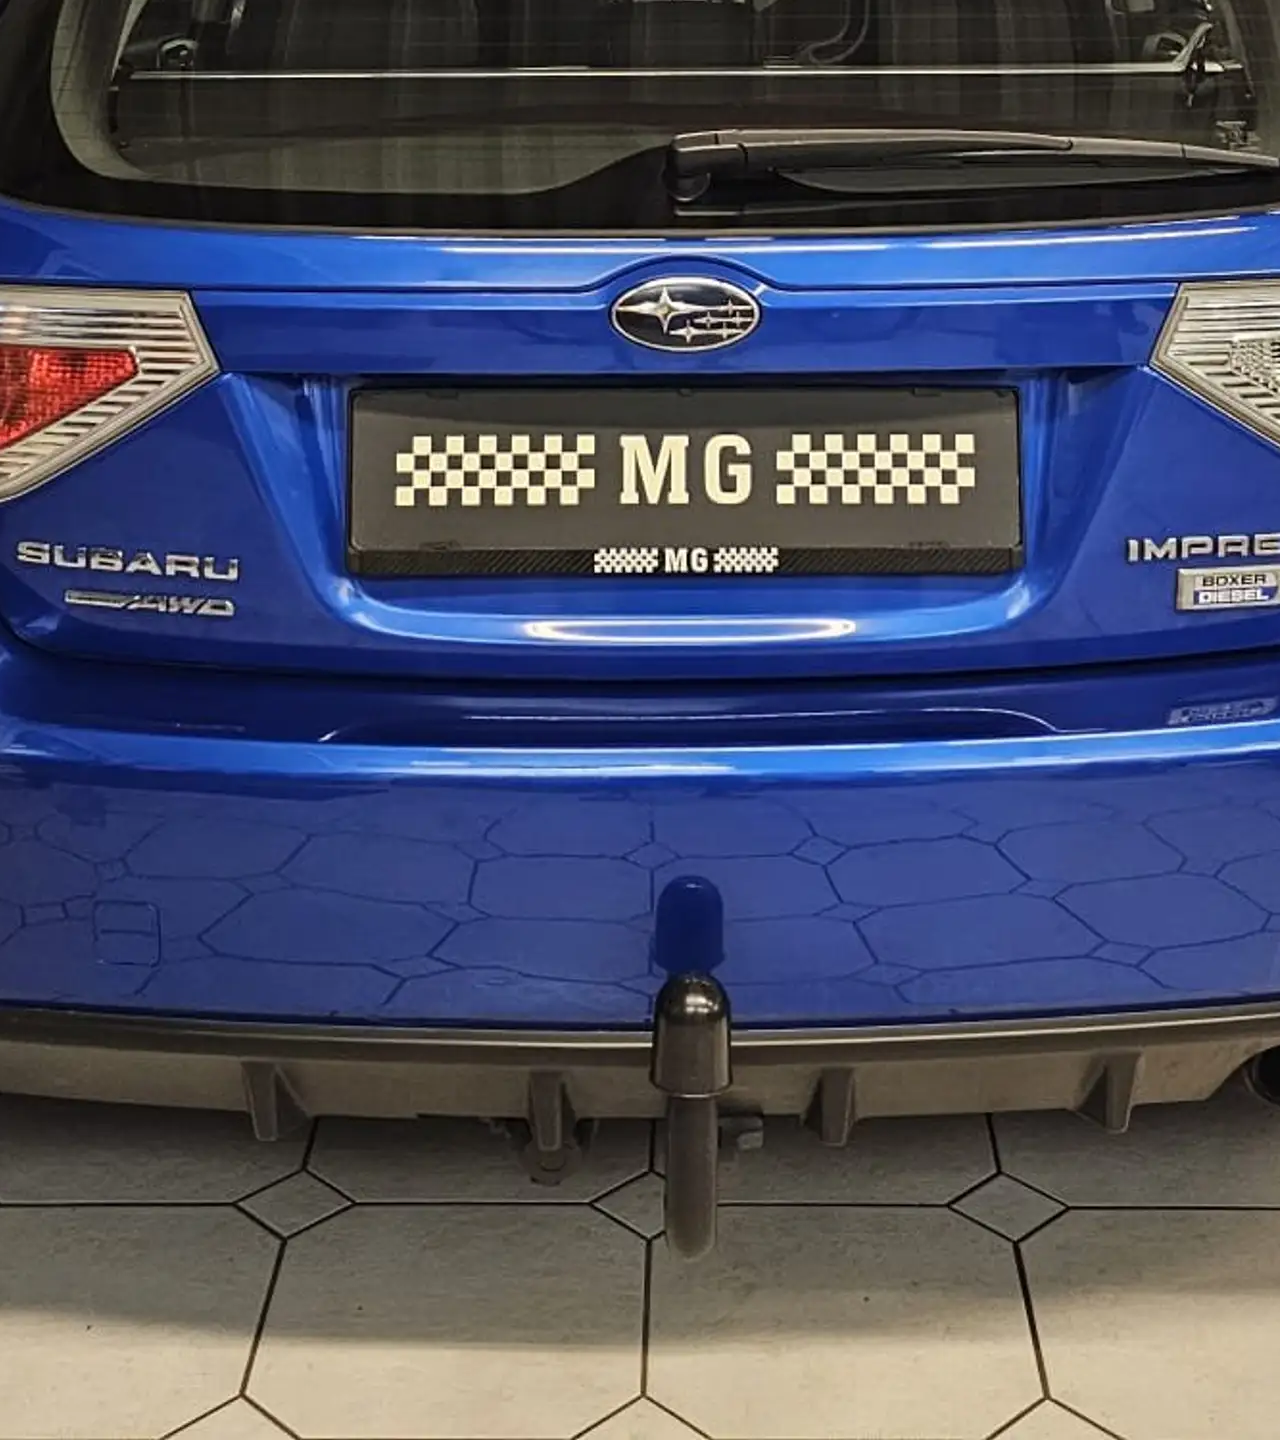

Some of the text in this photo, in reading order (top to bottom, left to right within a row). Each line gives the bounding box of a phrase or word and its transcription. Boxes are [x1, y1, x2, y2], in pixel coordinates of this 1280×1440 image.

[619, 433, 753, 505] MG
[17, 541, 240, 582] SUBARU
[664, 547, 709, 573] MG
[1202, 573, 1268, 588] BOXER
[126, 594, 236, 618] AWD
[1198, 589, 1270, 604] DIESEL
